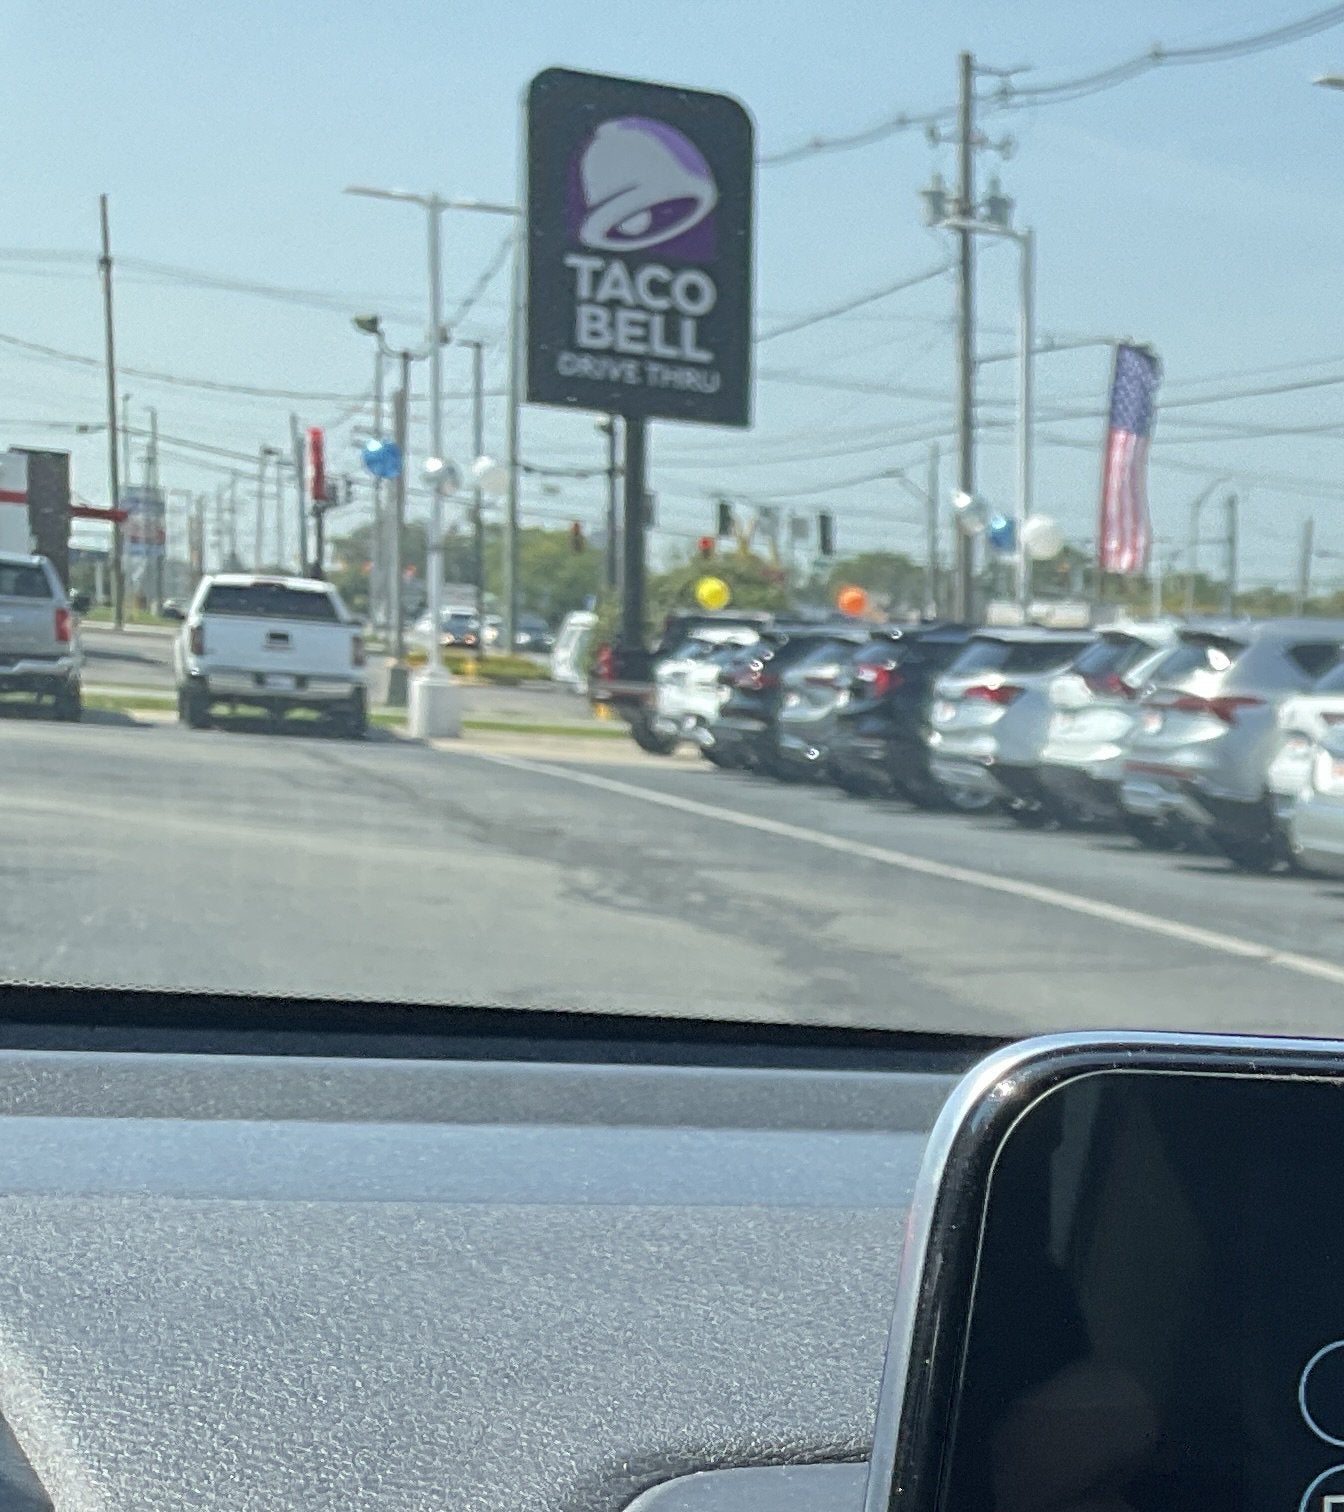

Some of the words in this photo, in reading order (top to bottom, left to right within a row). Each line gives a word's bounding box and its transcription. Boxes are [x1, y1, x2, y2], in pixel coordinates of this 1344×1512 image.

[563, 253, 718, 318] TACO
[576, 304, 716, 364] BELL
[645, 361, 721, 393] THRU
